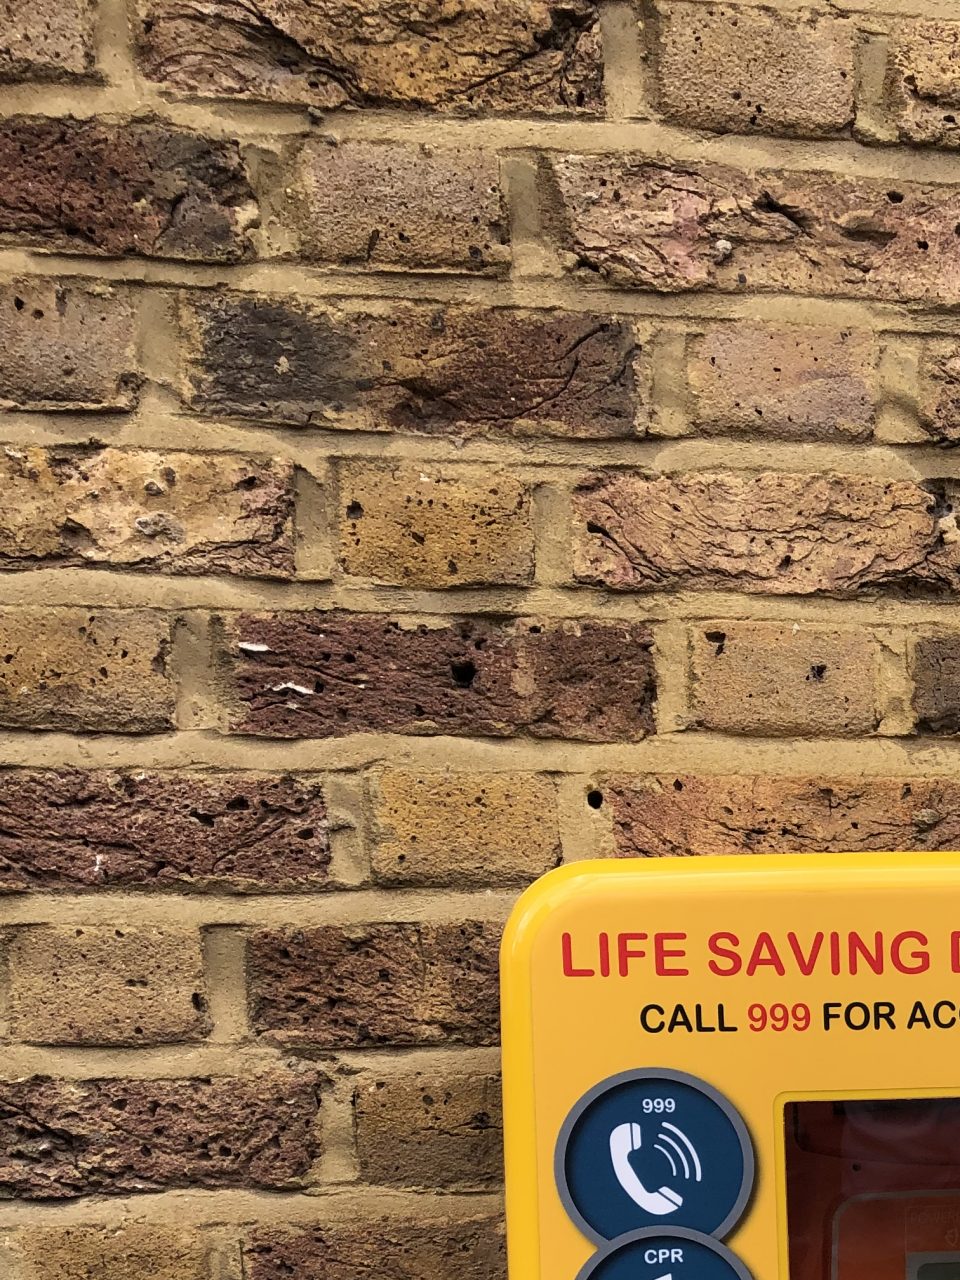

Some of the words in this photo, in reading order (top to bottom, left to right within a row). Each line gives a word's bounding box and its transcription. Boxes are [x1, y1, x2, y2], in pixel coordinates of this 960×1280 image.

[562, 933, 690, 978] LIFE
[707, 930, 931, 977] SAVING
[639, 1003, 738, 1034] CALL
[747, 1002, 811, 1033] 999
[822, 1001, 897, 1032] FOR
[642, 1098, 676, 1114] 999
[644, 1248, 684, 1264] CPR
